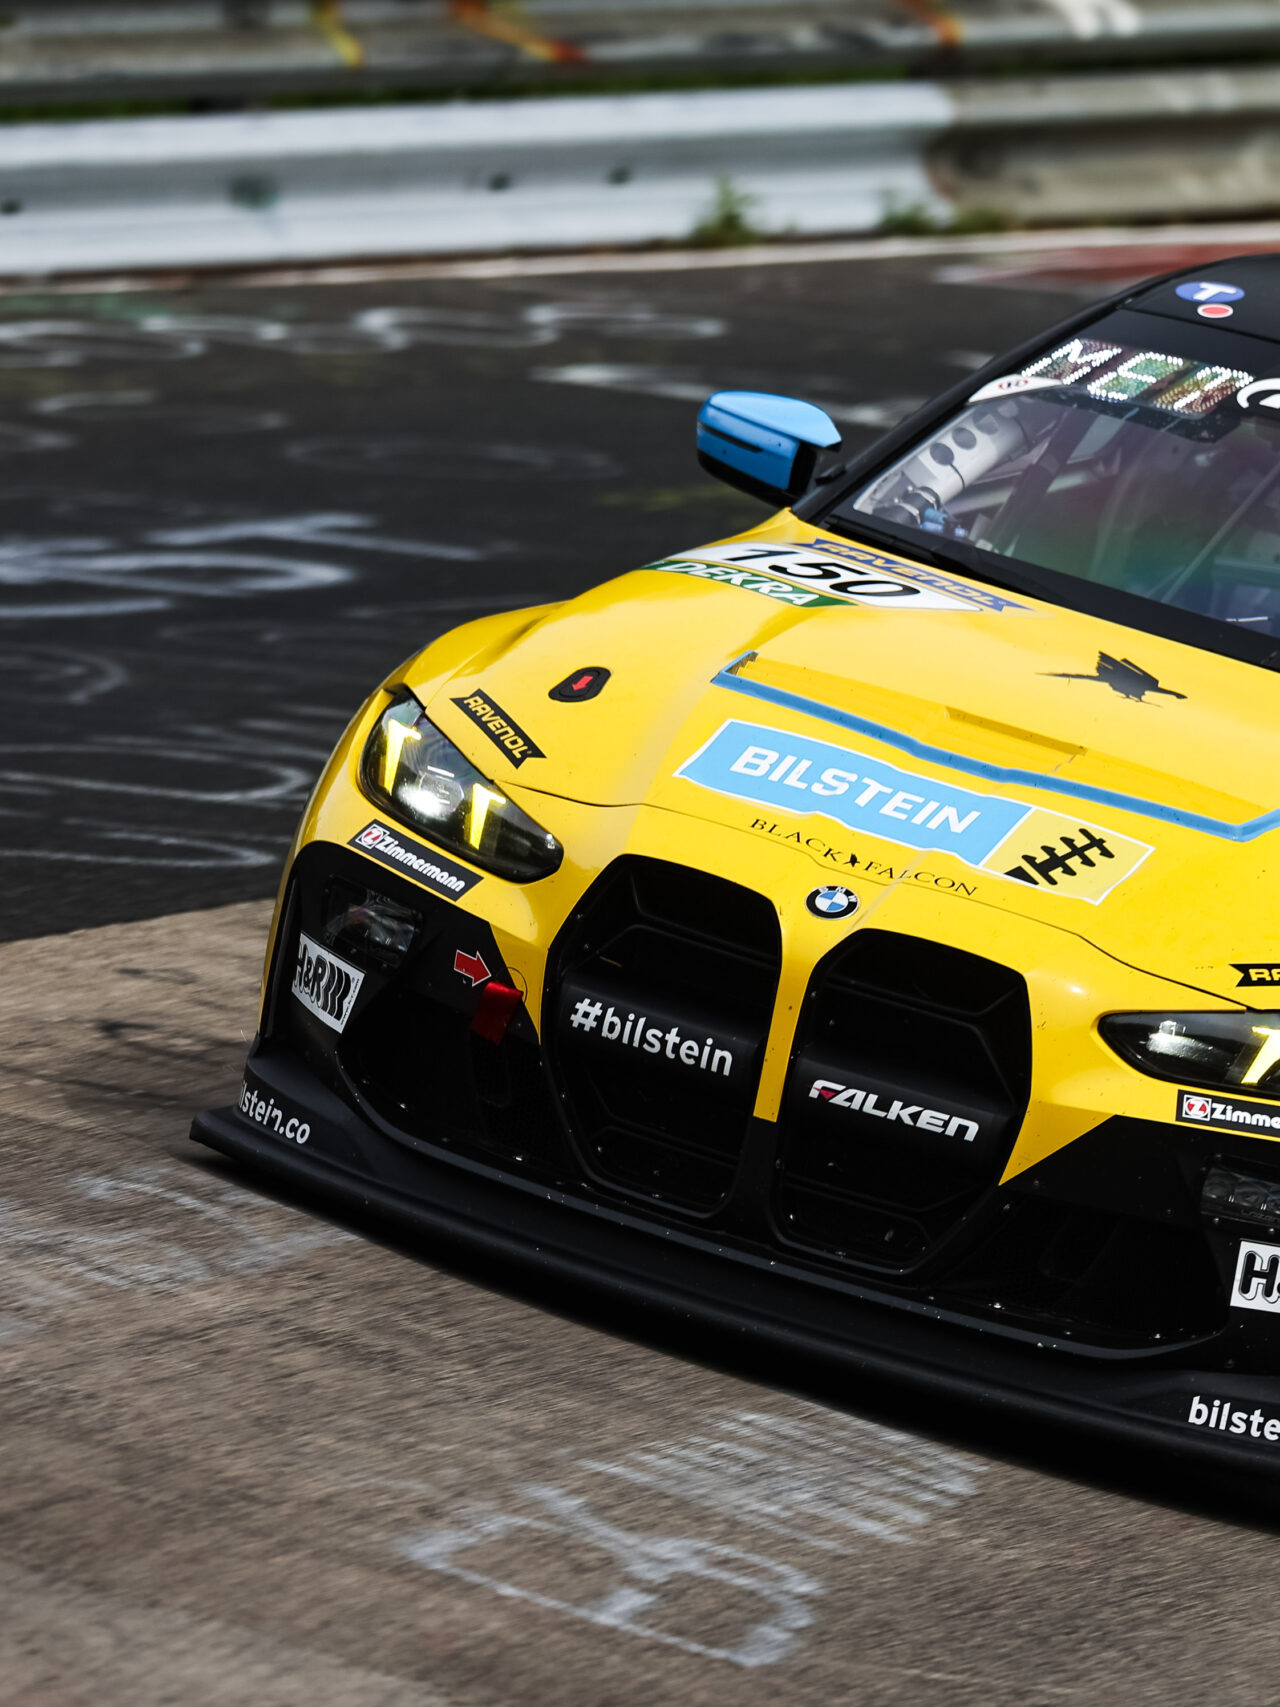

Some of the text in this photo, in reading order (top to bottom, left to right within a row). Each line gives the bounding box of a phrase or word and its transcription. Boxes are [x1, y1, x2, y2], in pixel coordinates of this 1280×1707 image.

[656, 562, 820, 606] DEKRA
[722, 549, 921, 597] 150
[813, 543, 996, 606] RAVENOL
[463, 695, 528, 759] RAVENOL
[729, 745, 982, 834] BILSTEIN
[375, 834, 466, 893] Zimmermann
[750, 818, 979, 896] BLACK FALCON
[570, 997, 734, 1077] #bilstein
[239, 1080, 311, 1145] lstein.co
[808, 1079, 981, 1142] FALKEN
